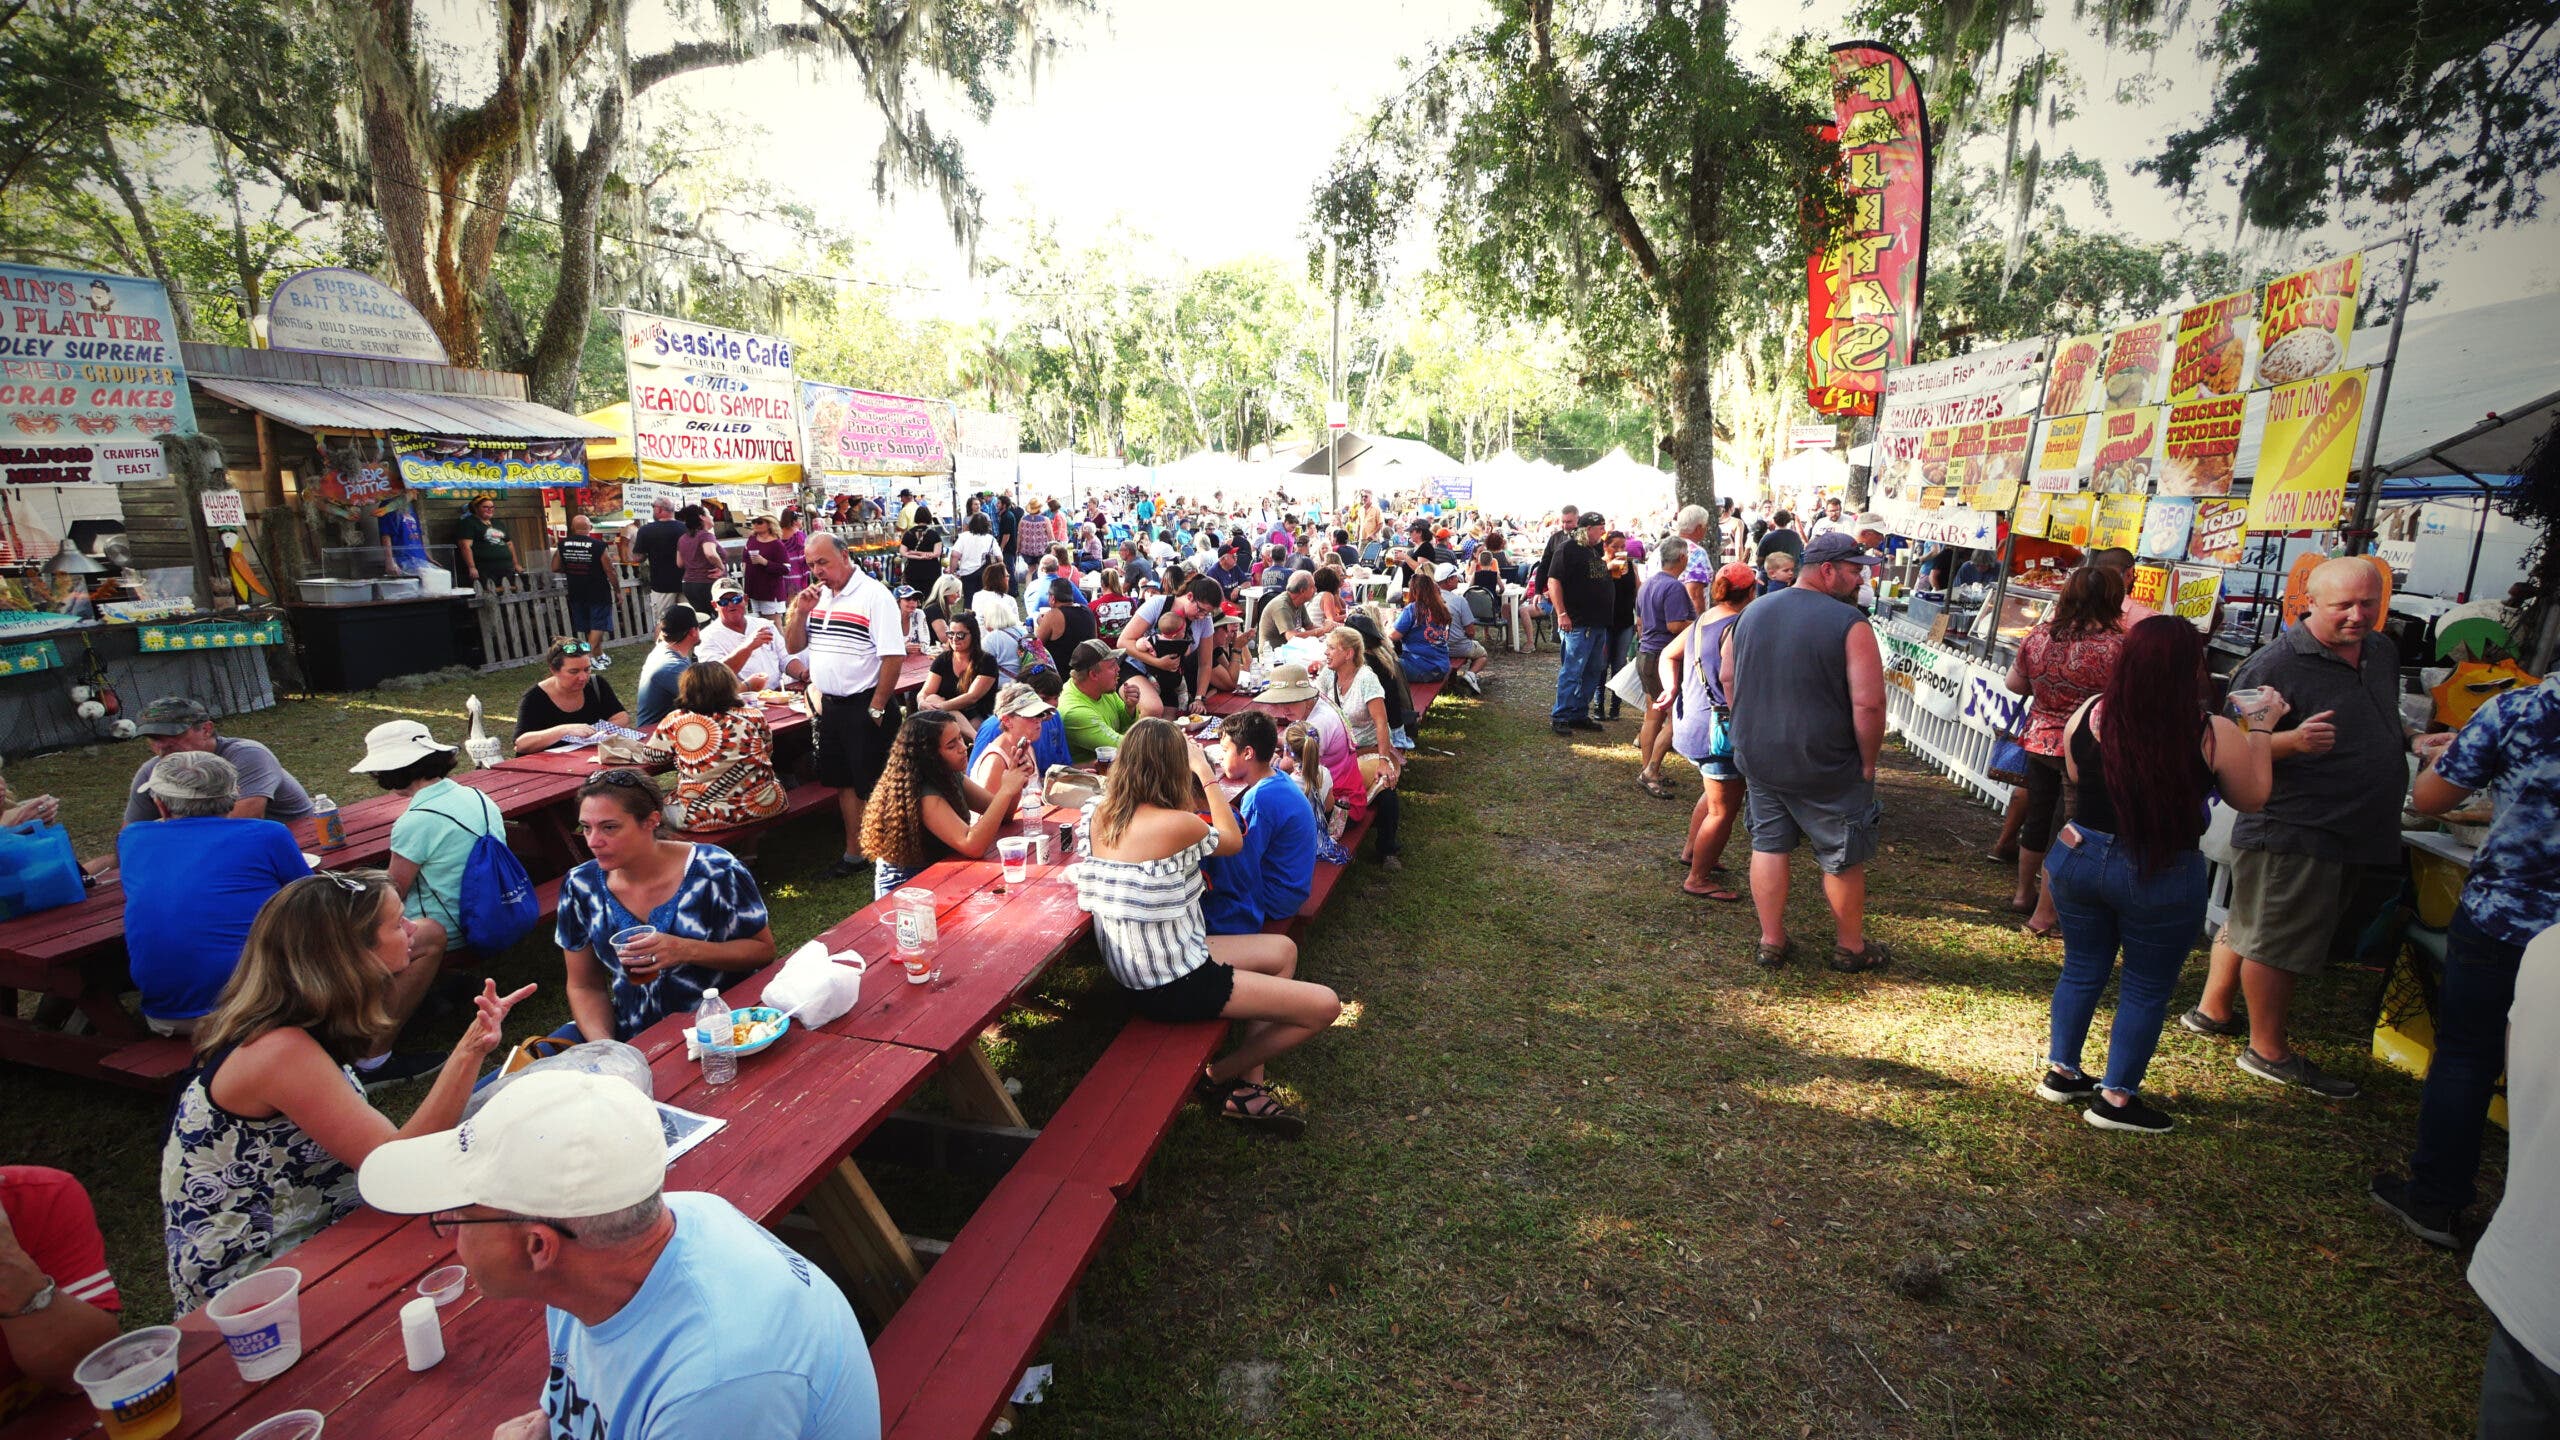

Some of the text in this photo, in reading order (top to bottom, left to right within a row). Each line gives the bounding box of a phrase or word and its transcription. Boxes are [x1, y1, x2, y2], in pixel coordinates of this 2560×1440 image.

[2263, 258, 2356, 324] FUNNEL
[290, 291, 407, 320] BAIT & TACKLE
[2180, 292, 2253, 333] DEEP FRIED
[13, 306, 163, 342] PLATTER
[273, 315, 433, 344] WORMS WILD SHINERS CRICKETS
[2263, 299, 2340, 353] CAKES
[65, 341, 166, 363] SUPREME
[321, 336, 400, 354] GUIDE SERVICE
[654, 328, 790, 368] Seaside Café
[2173, 316, 2235, 373] PICKLE
[2, 360, 177, 386] RIED GROUPER
[1952, 363, 1975, 385] Fish
[2170, 347, 2222, 397] CHIPS
[0, 384, 175, 409] CRAB CAKES
[636, 385, 793, 420] SEAFOOD SAMPLER
[2267, 381, 2330, 423] FOOT LONG
[1937, 400, 1968, 425] WITH
[1968, 394, 2003, 422] FRIES
[2169, 398, 2244, 423] CHICKEN
[685, 420, 752, 434] GRILLED
[847, 420, 897, 436] Pirate's
[2108, 412, 2136, 439] FRIED
[2167, 419, 2242, 443] TENDERS
[103, 447, 160, 461] CRAWFISH
[394, 441, 437, 455] Bobbie's
[466, 437, 528, 450] Famous
[638, 433, 710, 460] GROUPER
[712, 437, 796, 462] SANDWICH
[841, 435, 883, 455] Super
[887, 439, 941, 458] Sampler
[6, 466, 92, 484] MEDLEY
[116, 463, 151, 475] FEAST
[401, 459, 584, 482] Crabbie Patties
[2037, 476, 2071, 491] COLESLAW
[204, 495, 241, 510] ALLIGATOR
[770, 499, 798, 507] SHRIMP
[2265, 492, 2299, 524] CORN
[2301, 488, 2340, 522] DOGS
[211, 510, 241, 525] SKEWER
[2201, 507, 2247, 535] ICED
[1917, 521, 1969, 546] CRABS
[2051, 524, 2071, 542] Cakes
[2101, 530, 2114, 547] Pie
[2202, 528, 2239, 552] TEA
[2178, 575, 2219, 602] CORN
[229, 1332, 267, 1347] BUD
